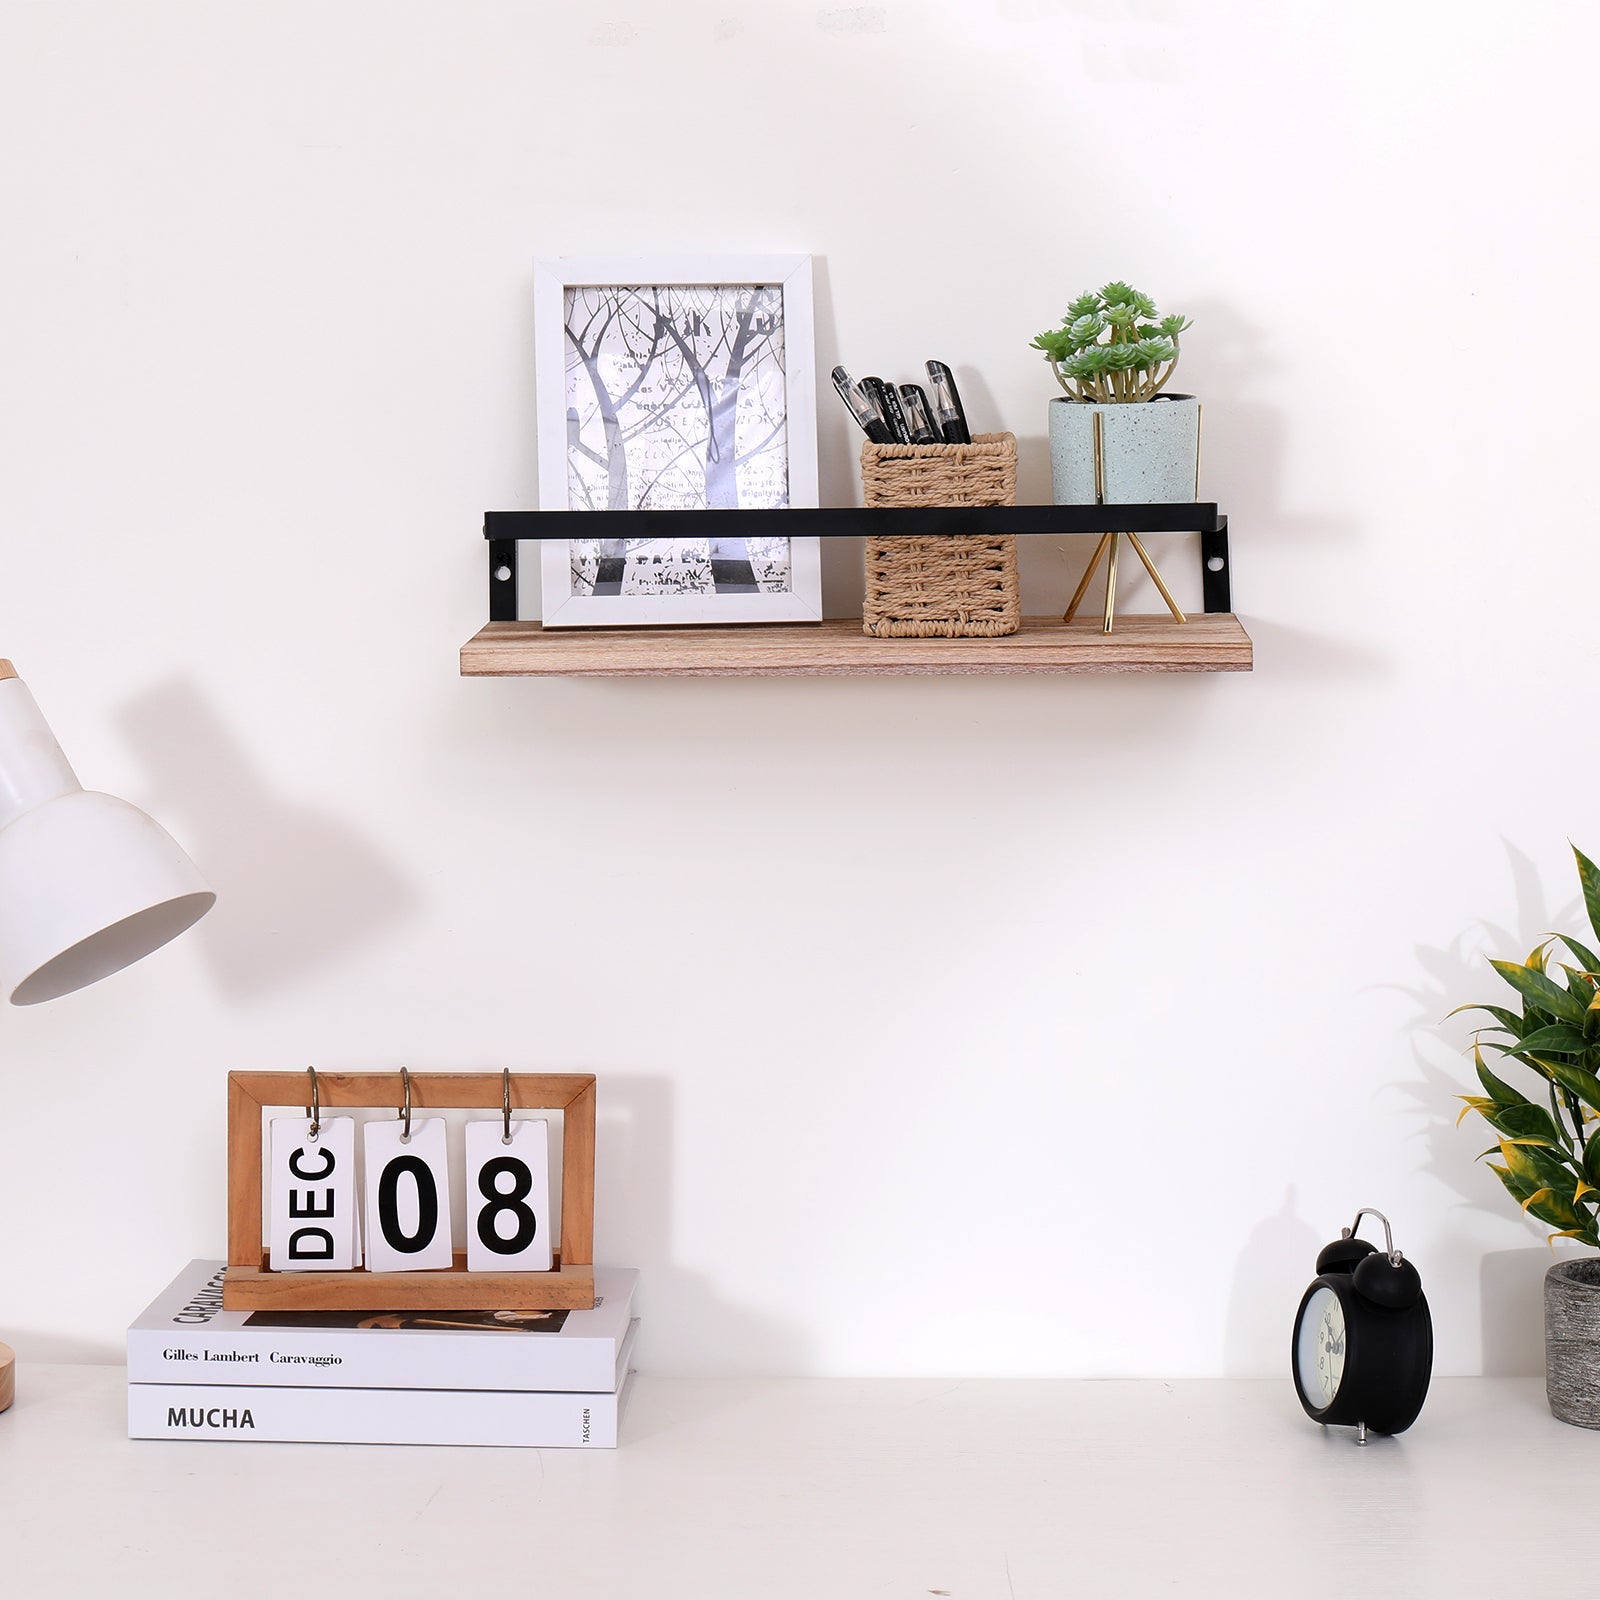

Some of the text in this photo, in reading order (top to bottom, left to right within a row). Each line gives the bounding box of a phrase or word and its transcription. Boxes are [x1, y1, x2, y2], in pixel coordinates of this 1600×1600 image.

[288, 1146, 336, 1260] DEC
[172, 1267, 228, 1324] CARAVA
[1319, 1331, 1325, 1345] 9
[162, 1348, 260, 1363] Gilles Lambert
[269, 1351, 343, 1368] Caravaggio
[1319, 1356, 1325, 1370] 8
[1324, 1375, 1329, 1389] 7
[167, 1407, 256, 1429] MUCHA
[582, 1408, 591, 1444] TASCHEN
